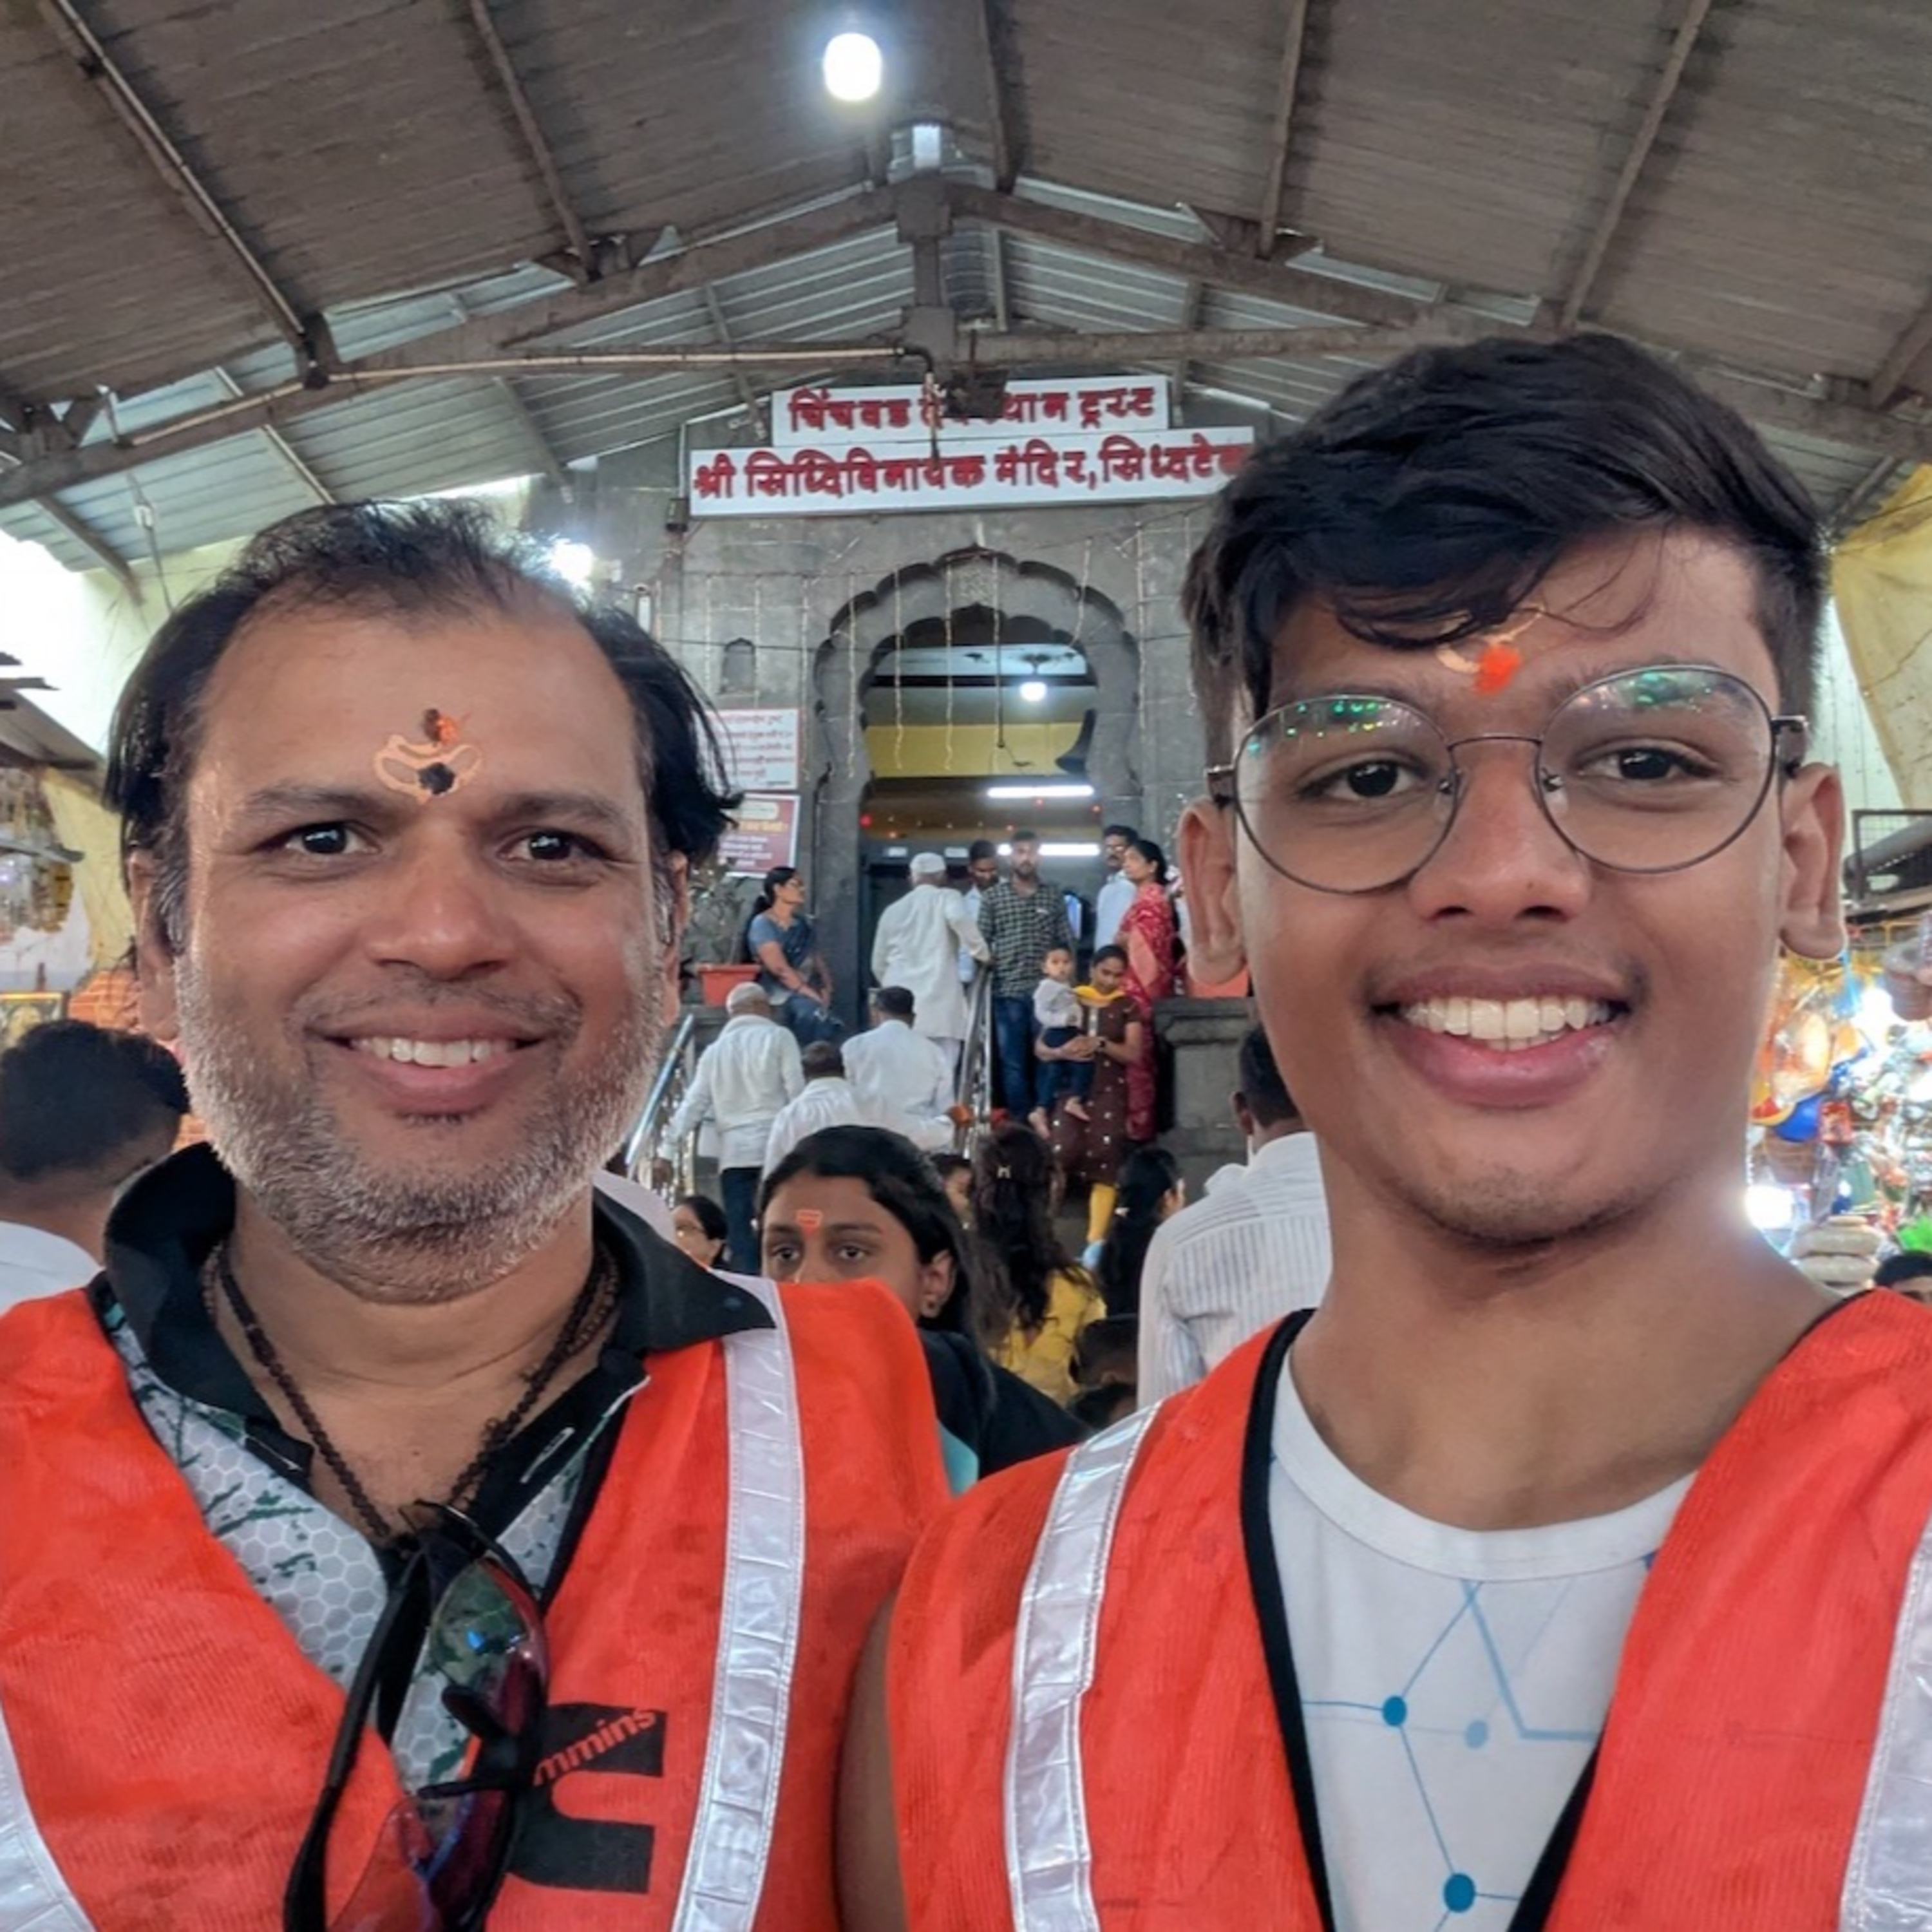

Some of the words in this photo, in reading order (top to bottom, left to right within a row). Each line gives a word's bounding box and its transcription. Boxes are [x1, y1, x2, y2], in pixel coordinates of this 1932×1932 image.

[788, 388, 910, 432] चिंचवड
[694, 453, 736, 498] श्री
[533, 1706, 658, 1786] mmins
